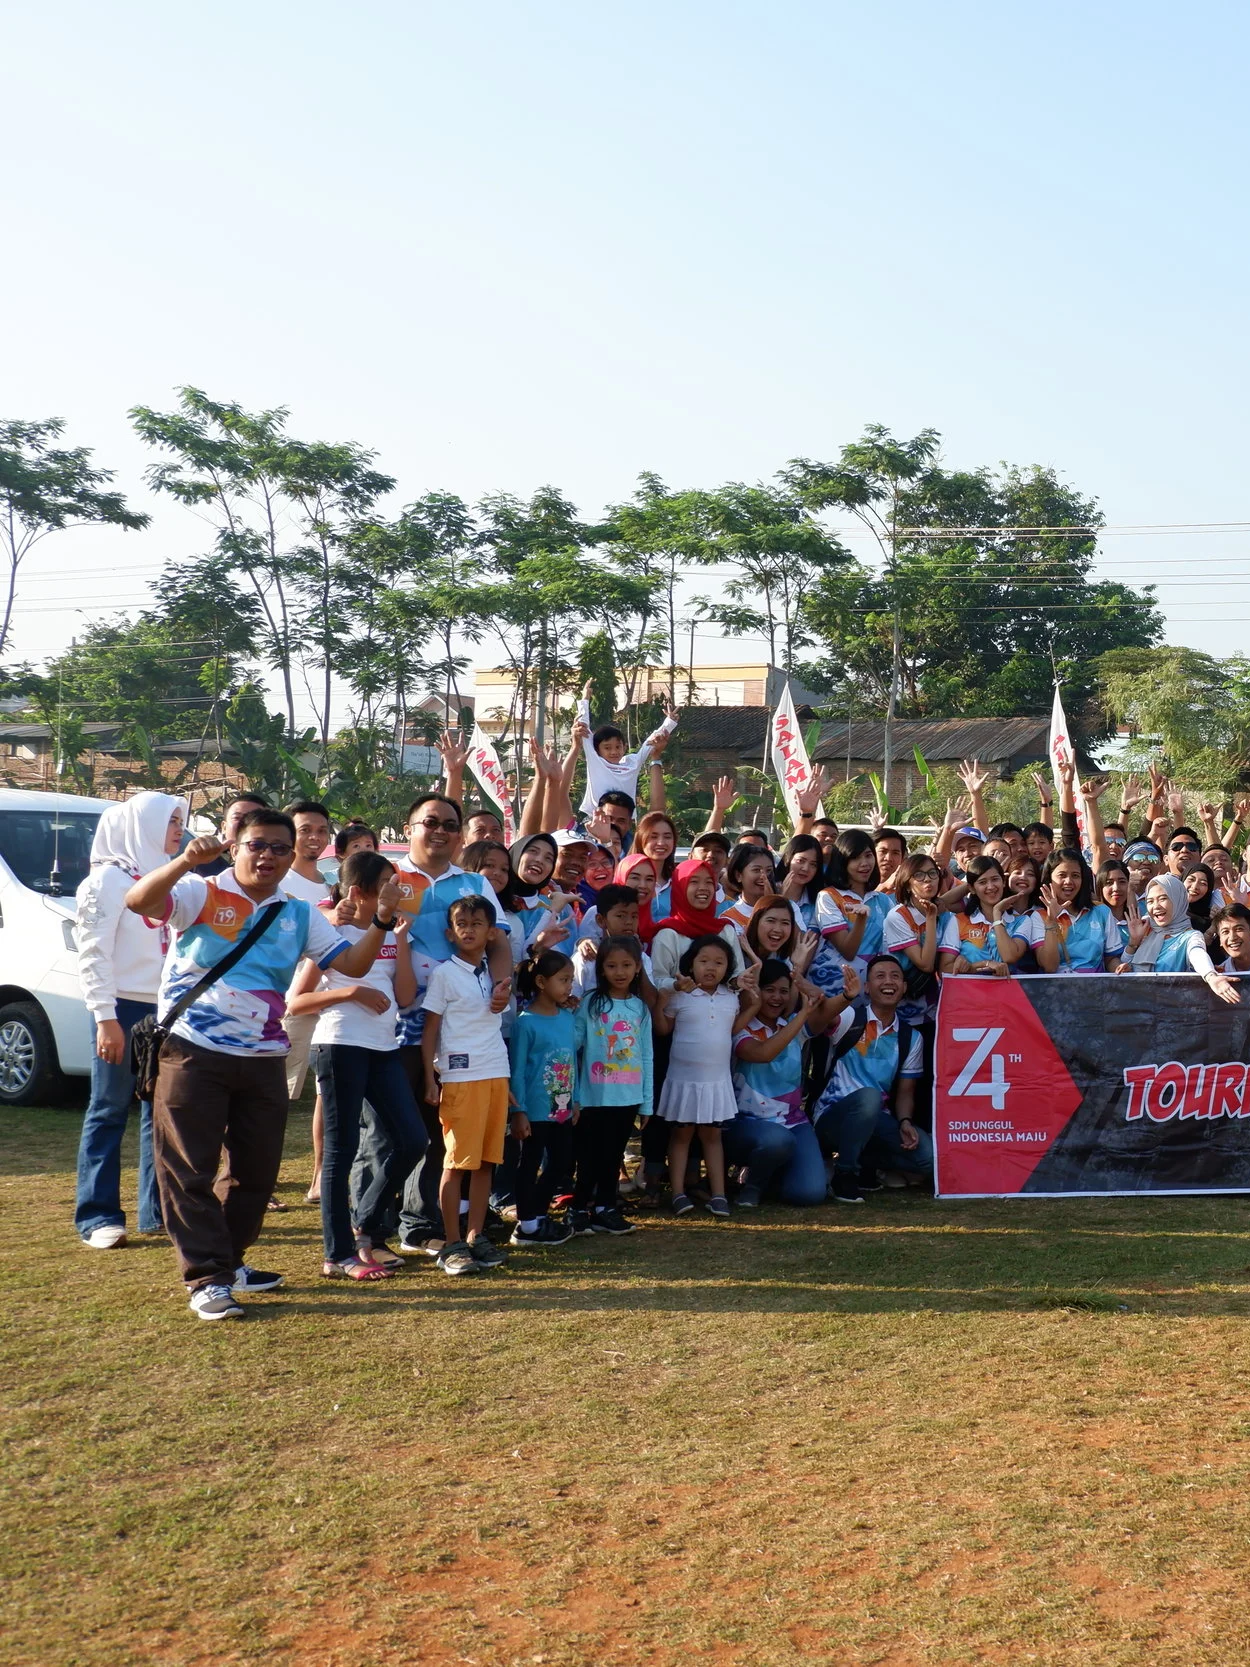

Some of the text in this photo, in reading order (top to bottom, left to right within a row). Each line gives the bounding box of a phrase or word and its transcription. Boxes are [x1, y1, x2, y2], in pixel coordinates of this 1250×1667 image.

[776, 714, 807, 789] SALAM
[218, 909, 234, 924] 19
[948, 1120, 1014, 1130] SDM UNGGUL
[948, 1131, 1047, 1142] INDONESIA MAJU
